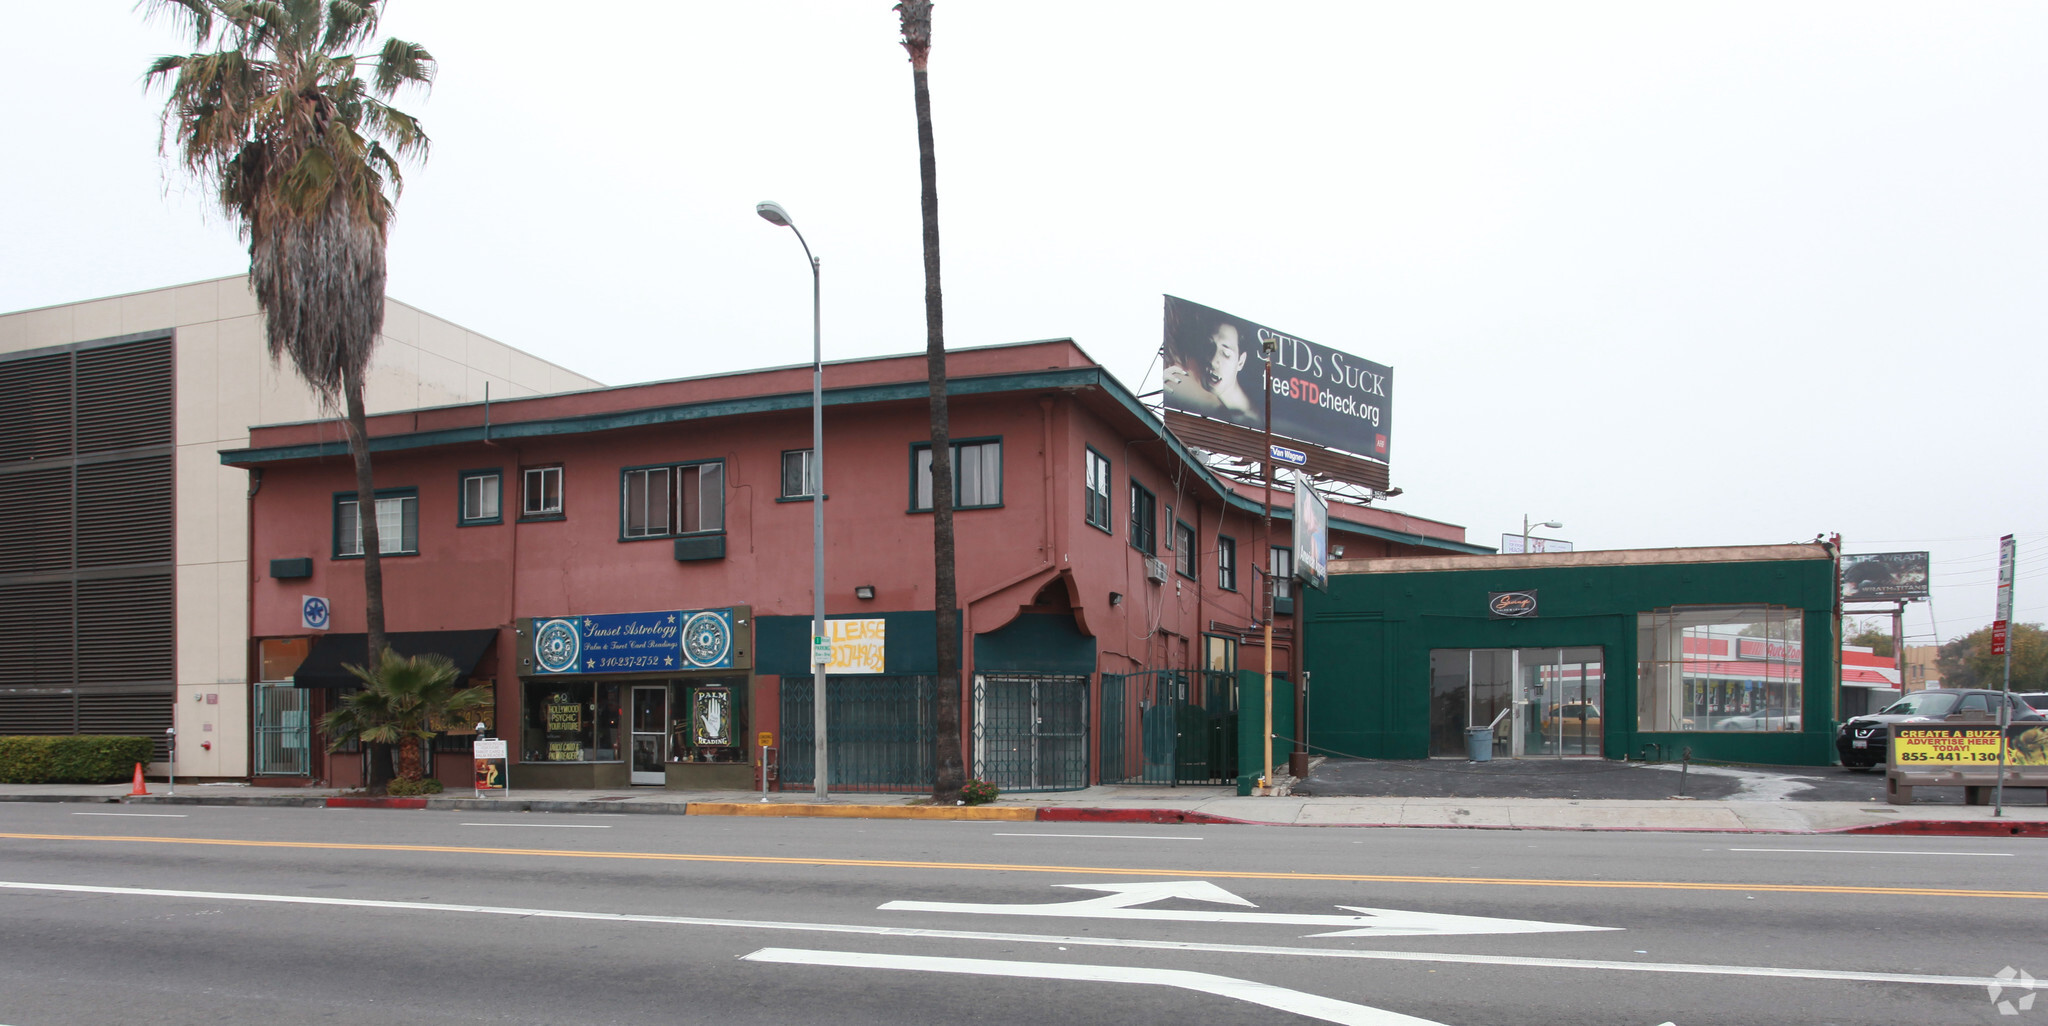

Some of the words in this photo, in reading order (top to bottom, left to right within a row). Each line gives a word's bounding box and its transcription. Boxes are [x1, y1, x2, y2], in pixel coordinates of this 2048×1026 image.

[1273, 447, 1283, 457] Van
[1284, 450, 1305, 463] Wagner
[1883, 552, 1927, 561] WRATH
[584, 623, 621, 637] Sunset
[624, 621, 677, 638] Astrology
[584, 642, 601, 650] Palm
[629, 641, 646, 649] Card
[648, 640, 677, 649] Readings
[600, 656, 659, 667] 310-237-2752
[698, 692, 727, 700] PALM
